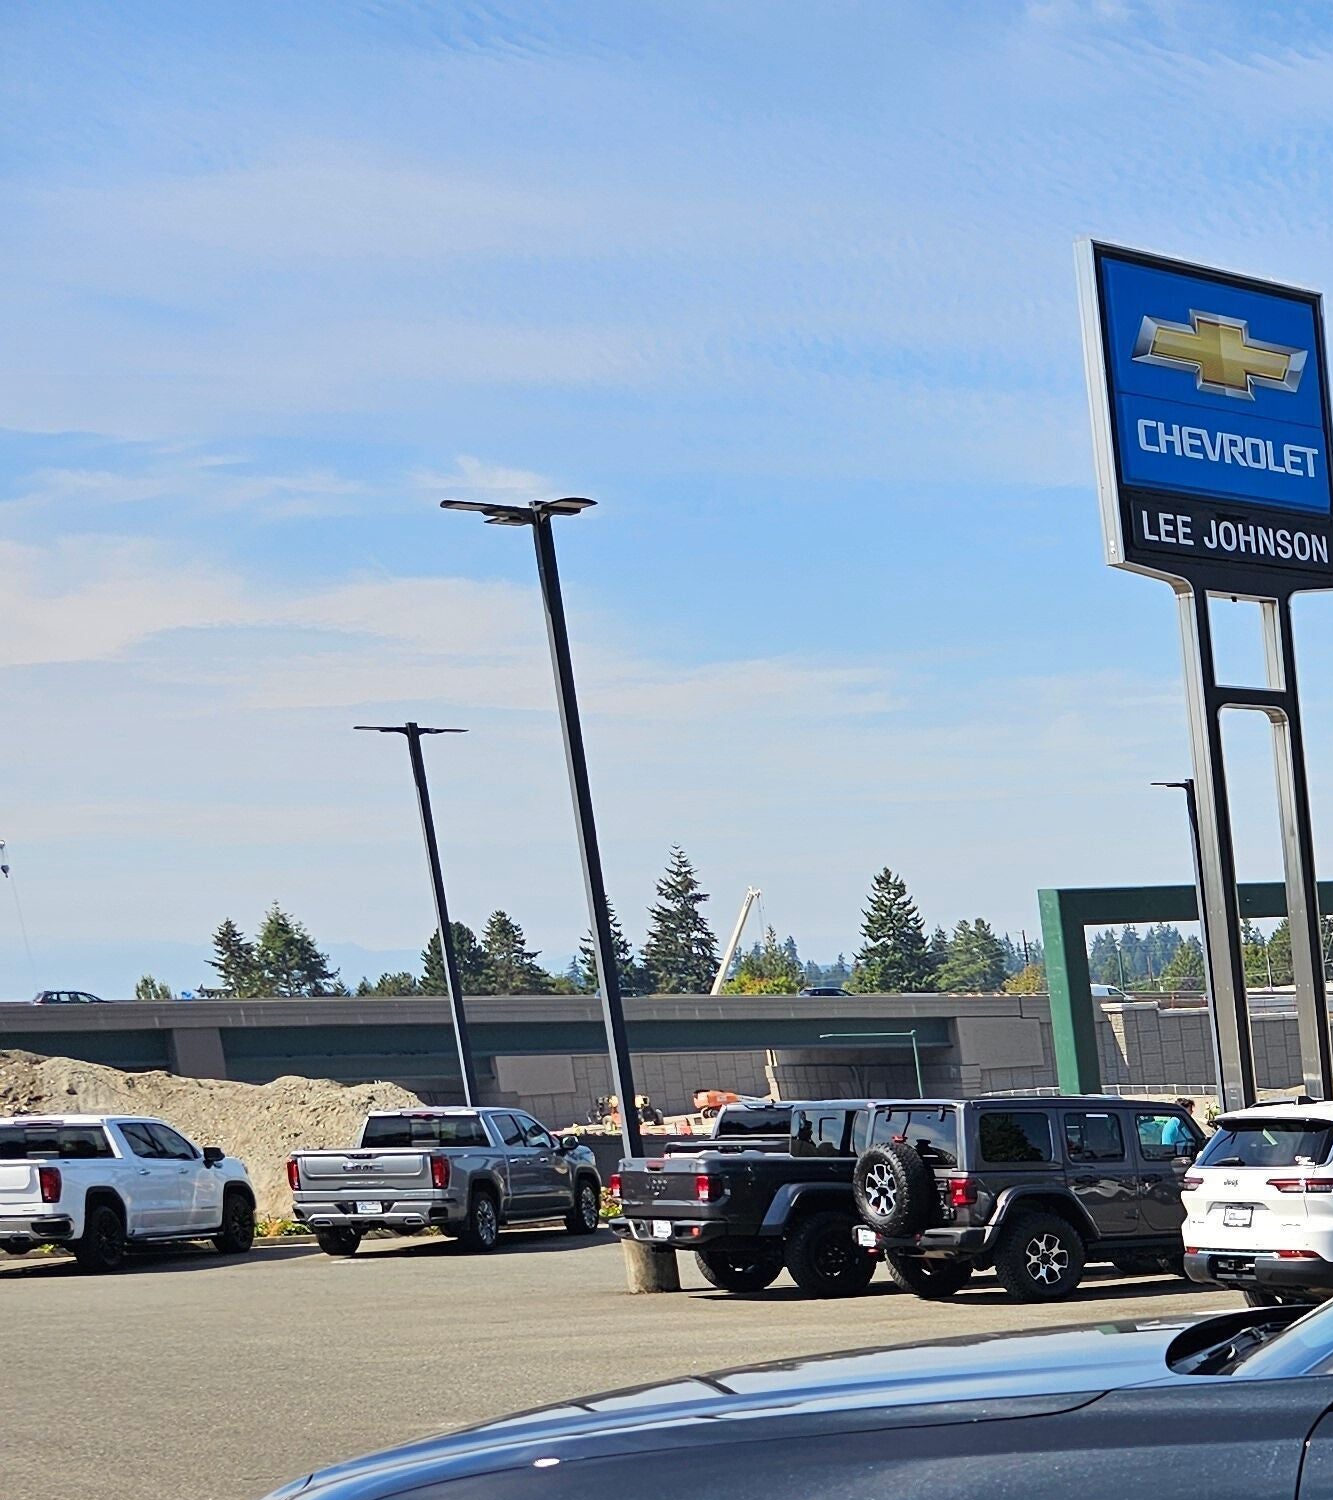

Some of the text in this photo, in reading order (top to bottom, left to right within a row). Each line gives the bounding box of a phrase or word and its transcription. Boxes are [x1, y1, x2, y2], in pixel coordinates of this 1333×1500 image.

[1137, 418, 1319, 478] CHEVROLET
[1141, 510, 1329, 564] LEE JOHNSON
